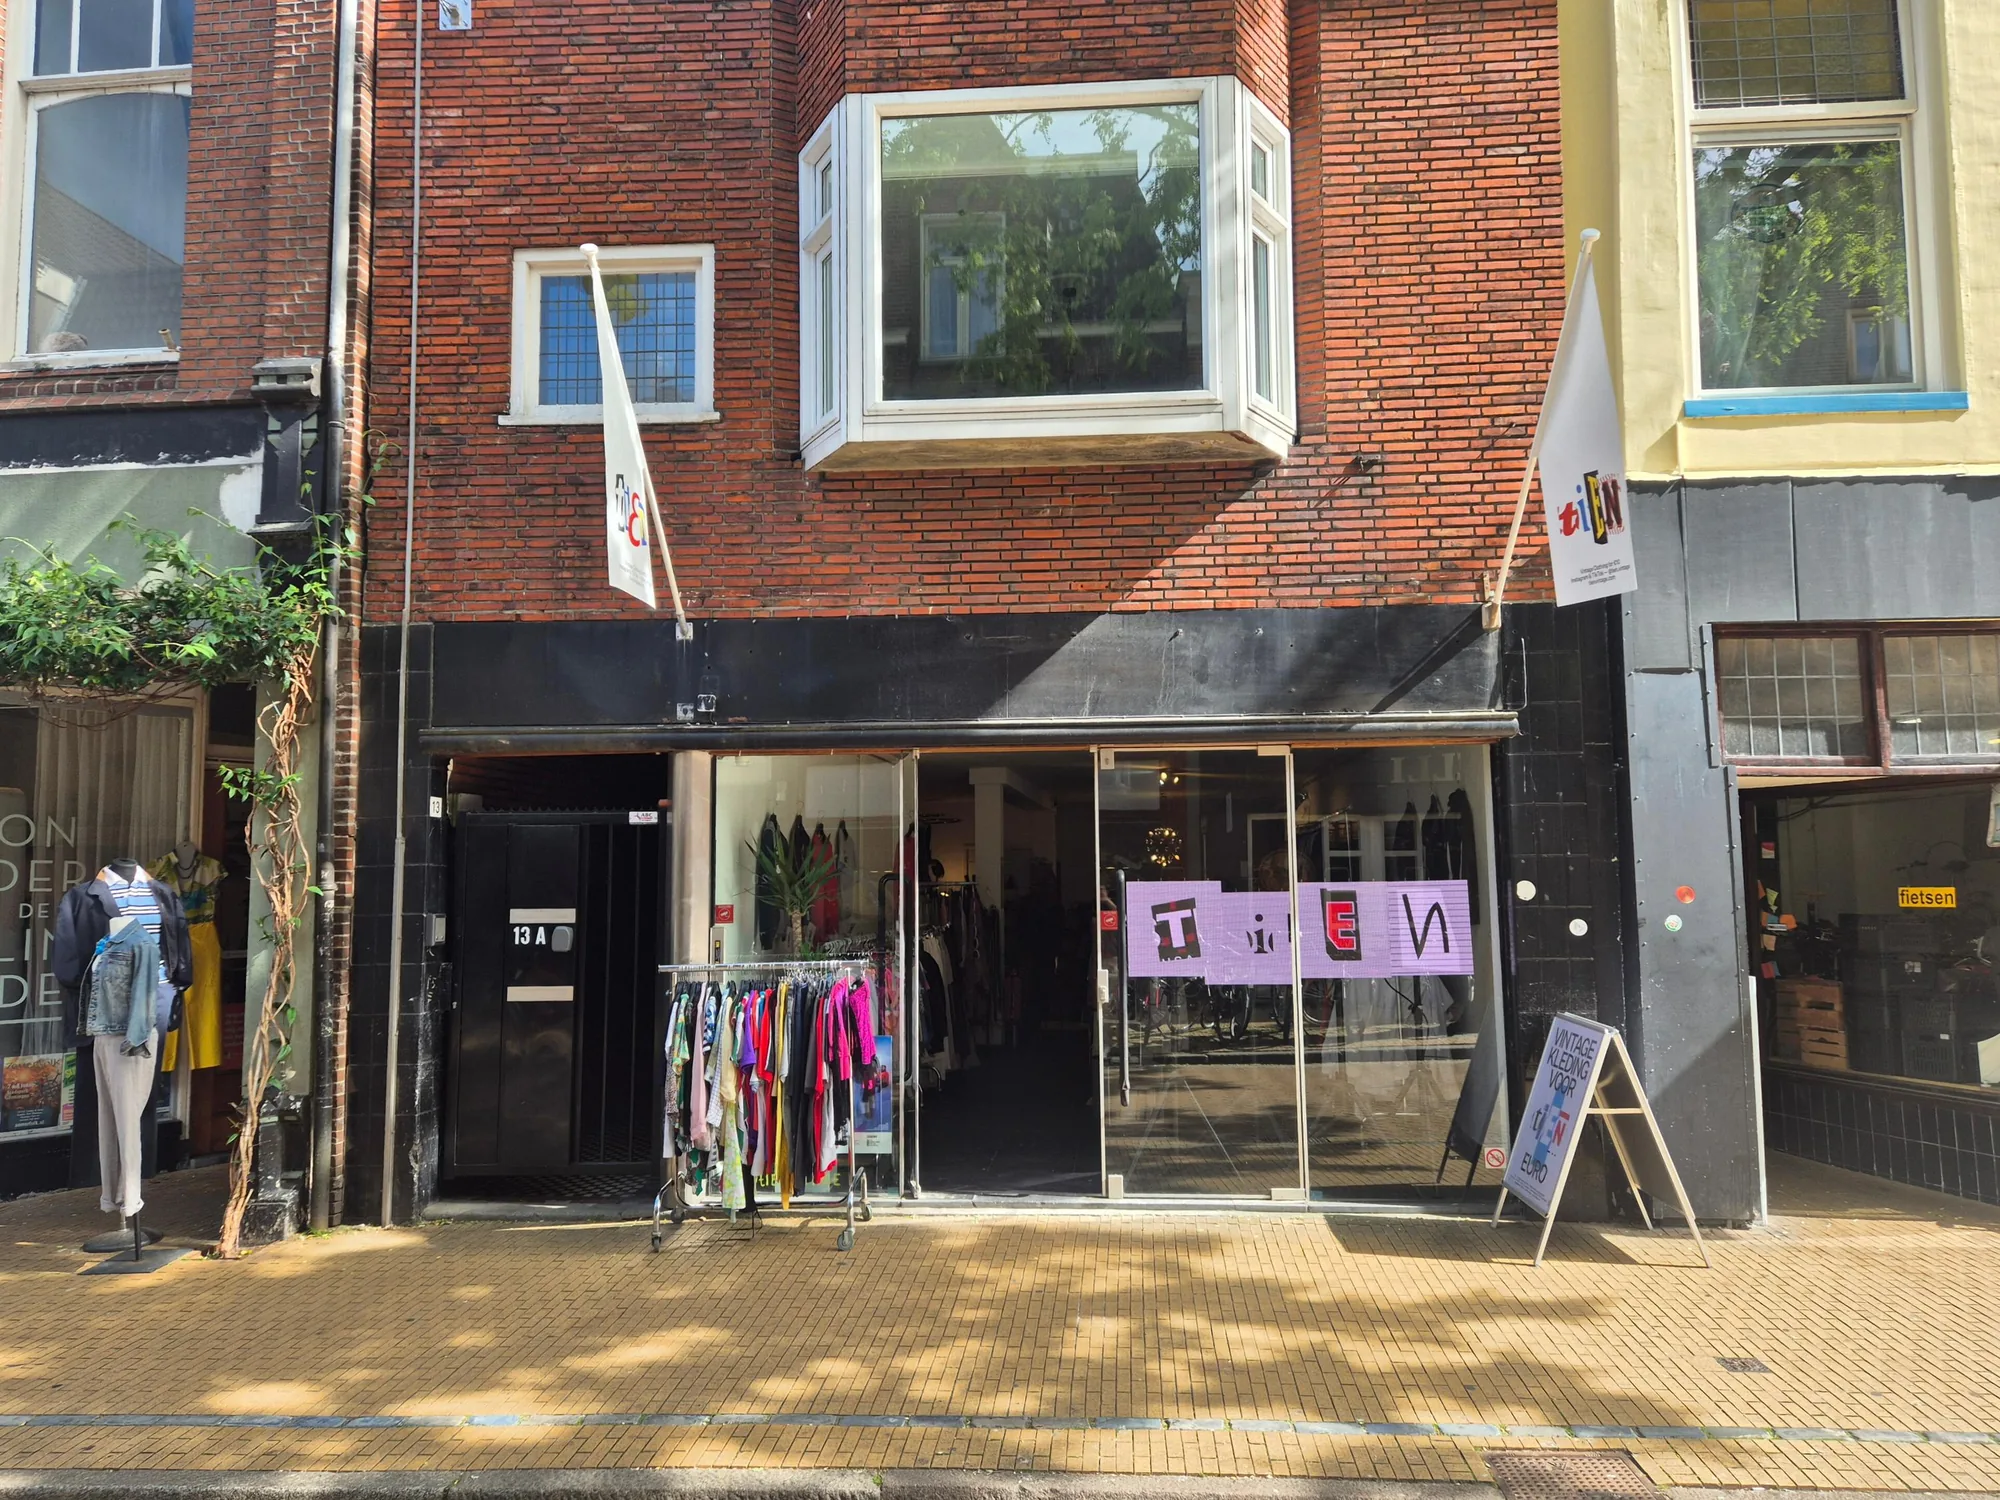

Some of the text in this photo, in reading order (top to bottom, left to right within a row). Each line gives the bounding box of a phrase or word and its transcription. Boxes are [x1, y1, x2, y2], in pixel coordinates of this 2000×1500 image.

[432, 801, 440, 814] 13
[0, 814, 76, 848] ON
[19, 903, 49, 918] DE
[1900, 890, 1954, 904] fietsen
[513, 926, 546, 945] 13 A
[1555, 1027, 1597, 1060] VINTAGE
[1547, 1046, 1590, 1080] KLEDING
[1549, 1069, 1577, 1098] VOOR
[1521, 1152, 1548, 1184] EURO
